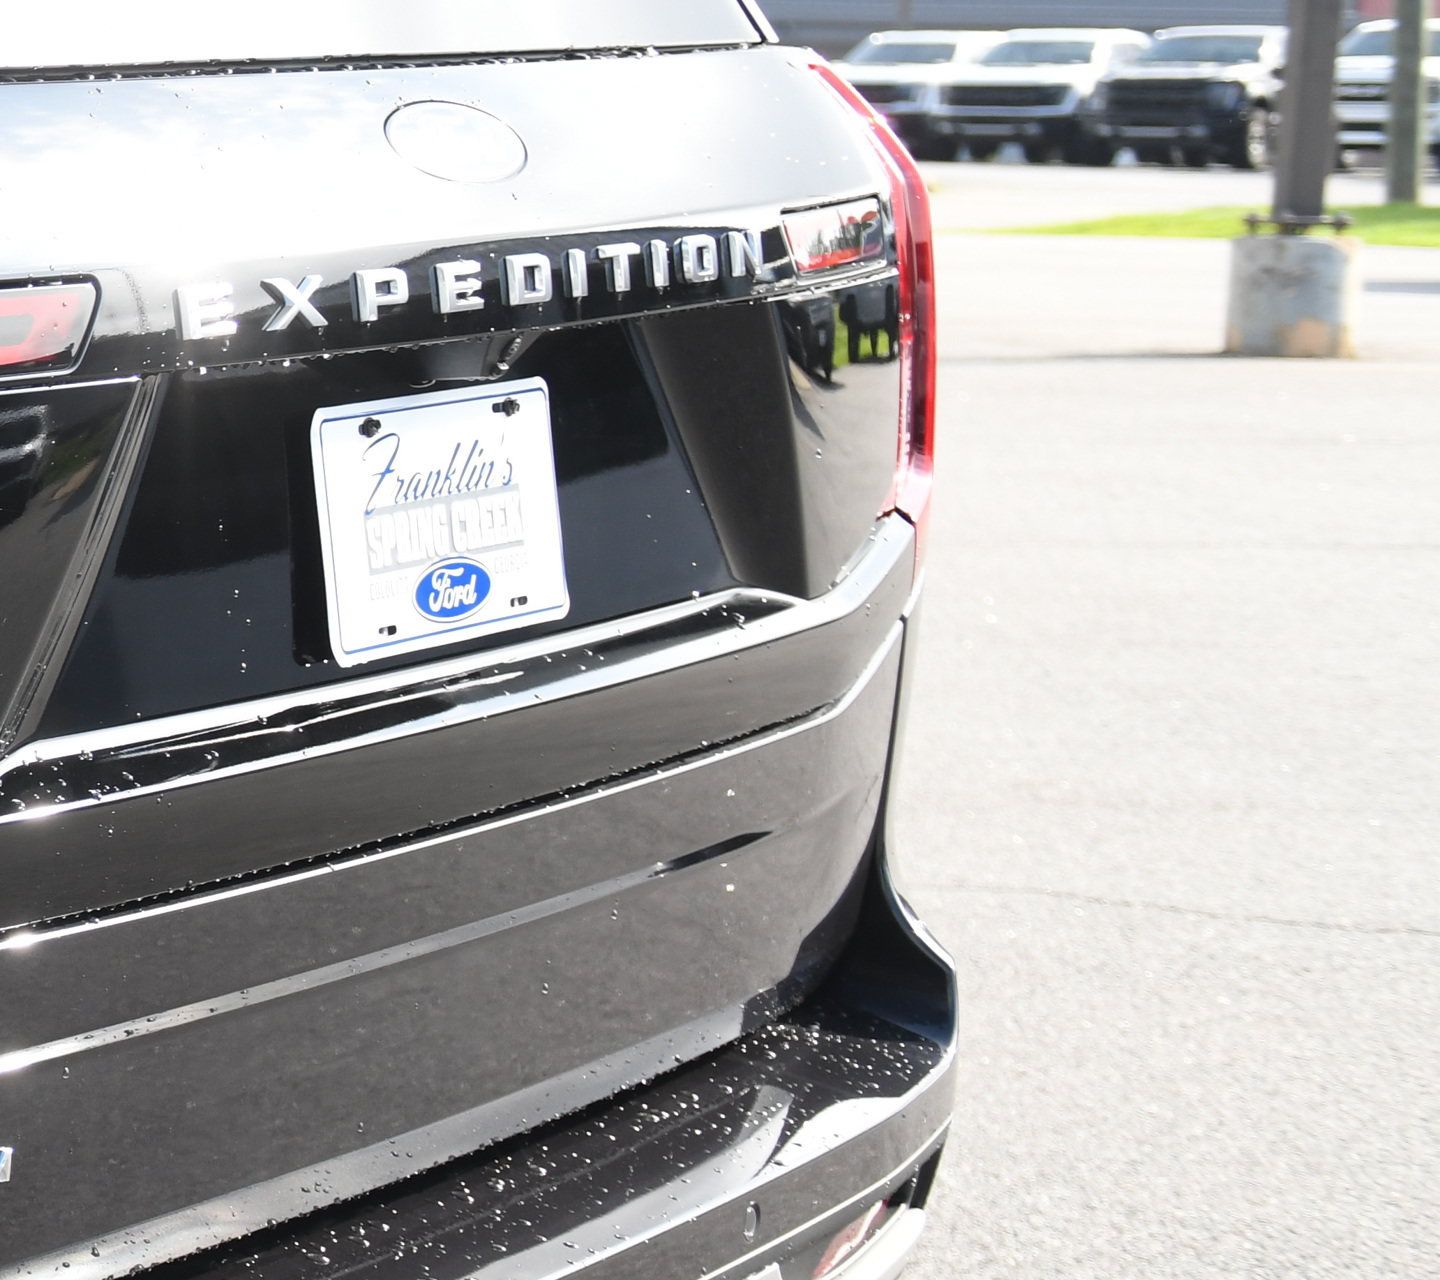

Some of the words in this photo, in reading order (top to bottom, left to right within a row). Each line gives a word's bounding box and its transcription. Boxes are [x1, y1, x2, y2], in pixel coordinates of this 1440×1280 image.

[173, 229, 765, 342] EXPEDITION
[362, 432, 513, 516] Franklin's
[365, 503, 450, 570] SPRING
[450, 489, 525, 553] CREEK
[428, 566, 479, 613] Ford
